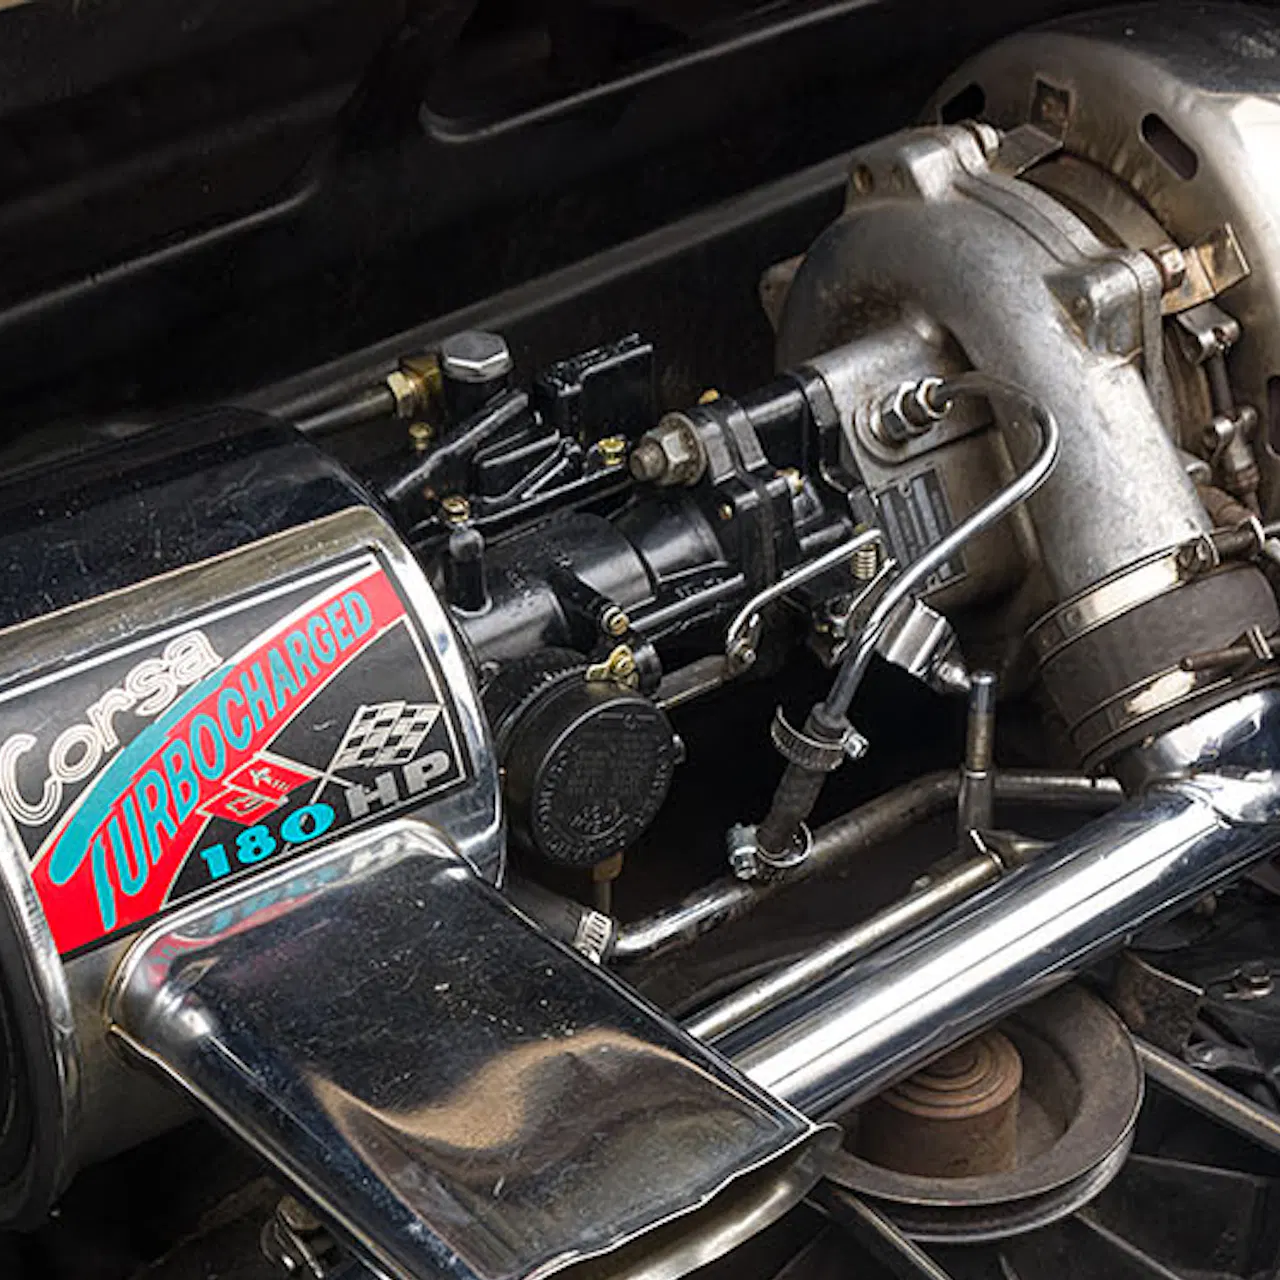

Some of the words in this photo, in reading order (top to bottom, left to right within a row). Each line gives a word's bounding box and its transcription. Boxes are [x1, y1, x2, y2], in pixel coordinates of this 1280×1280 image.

[50, 591, 373, 931] TURBOCHARGED
[201, 802, 334, 879] 180
[345, 750, 452, 818] HP
